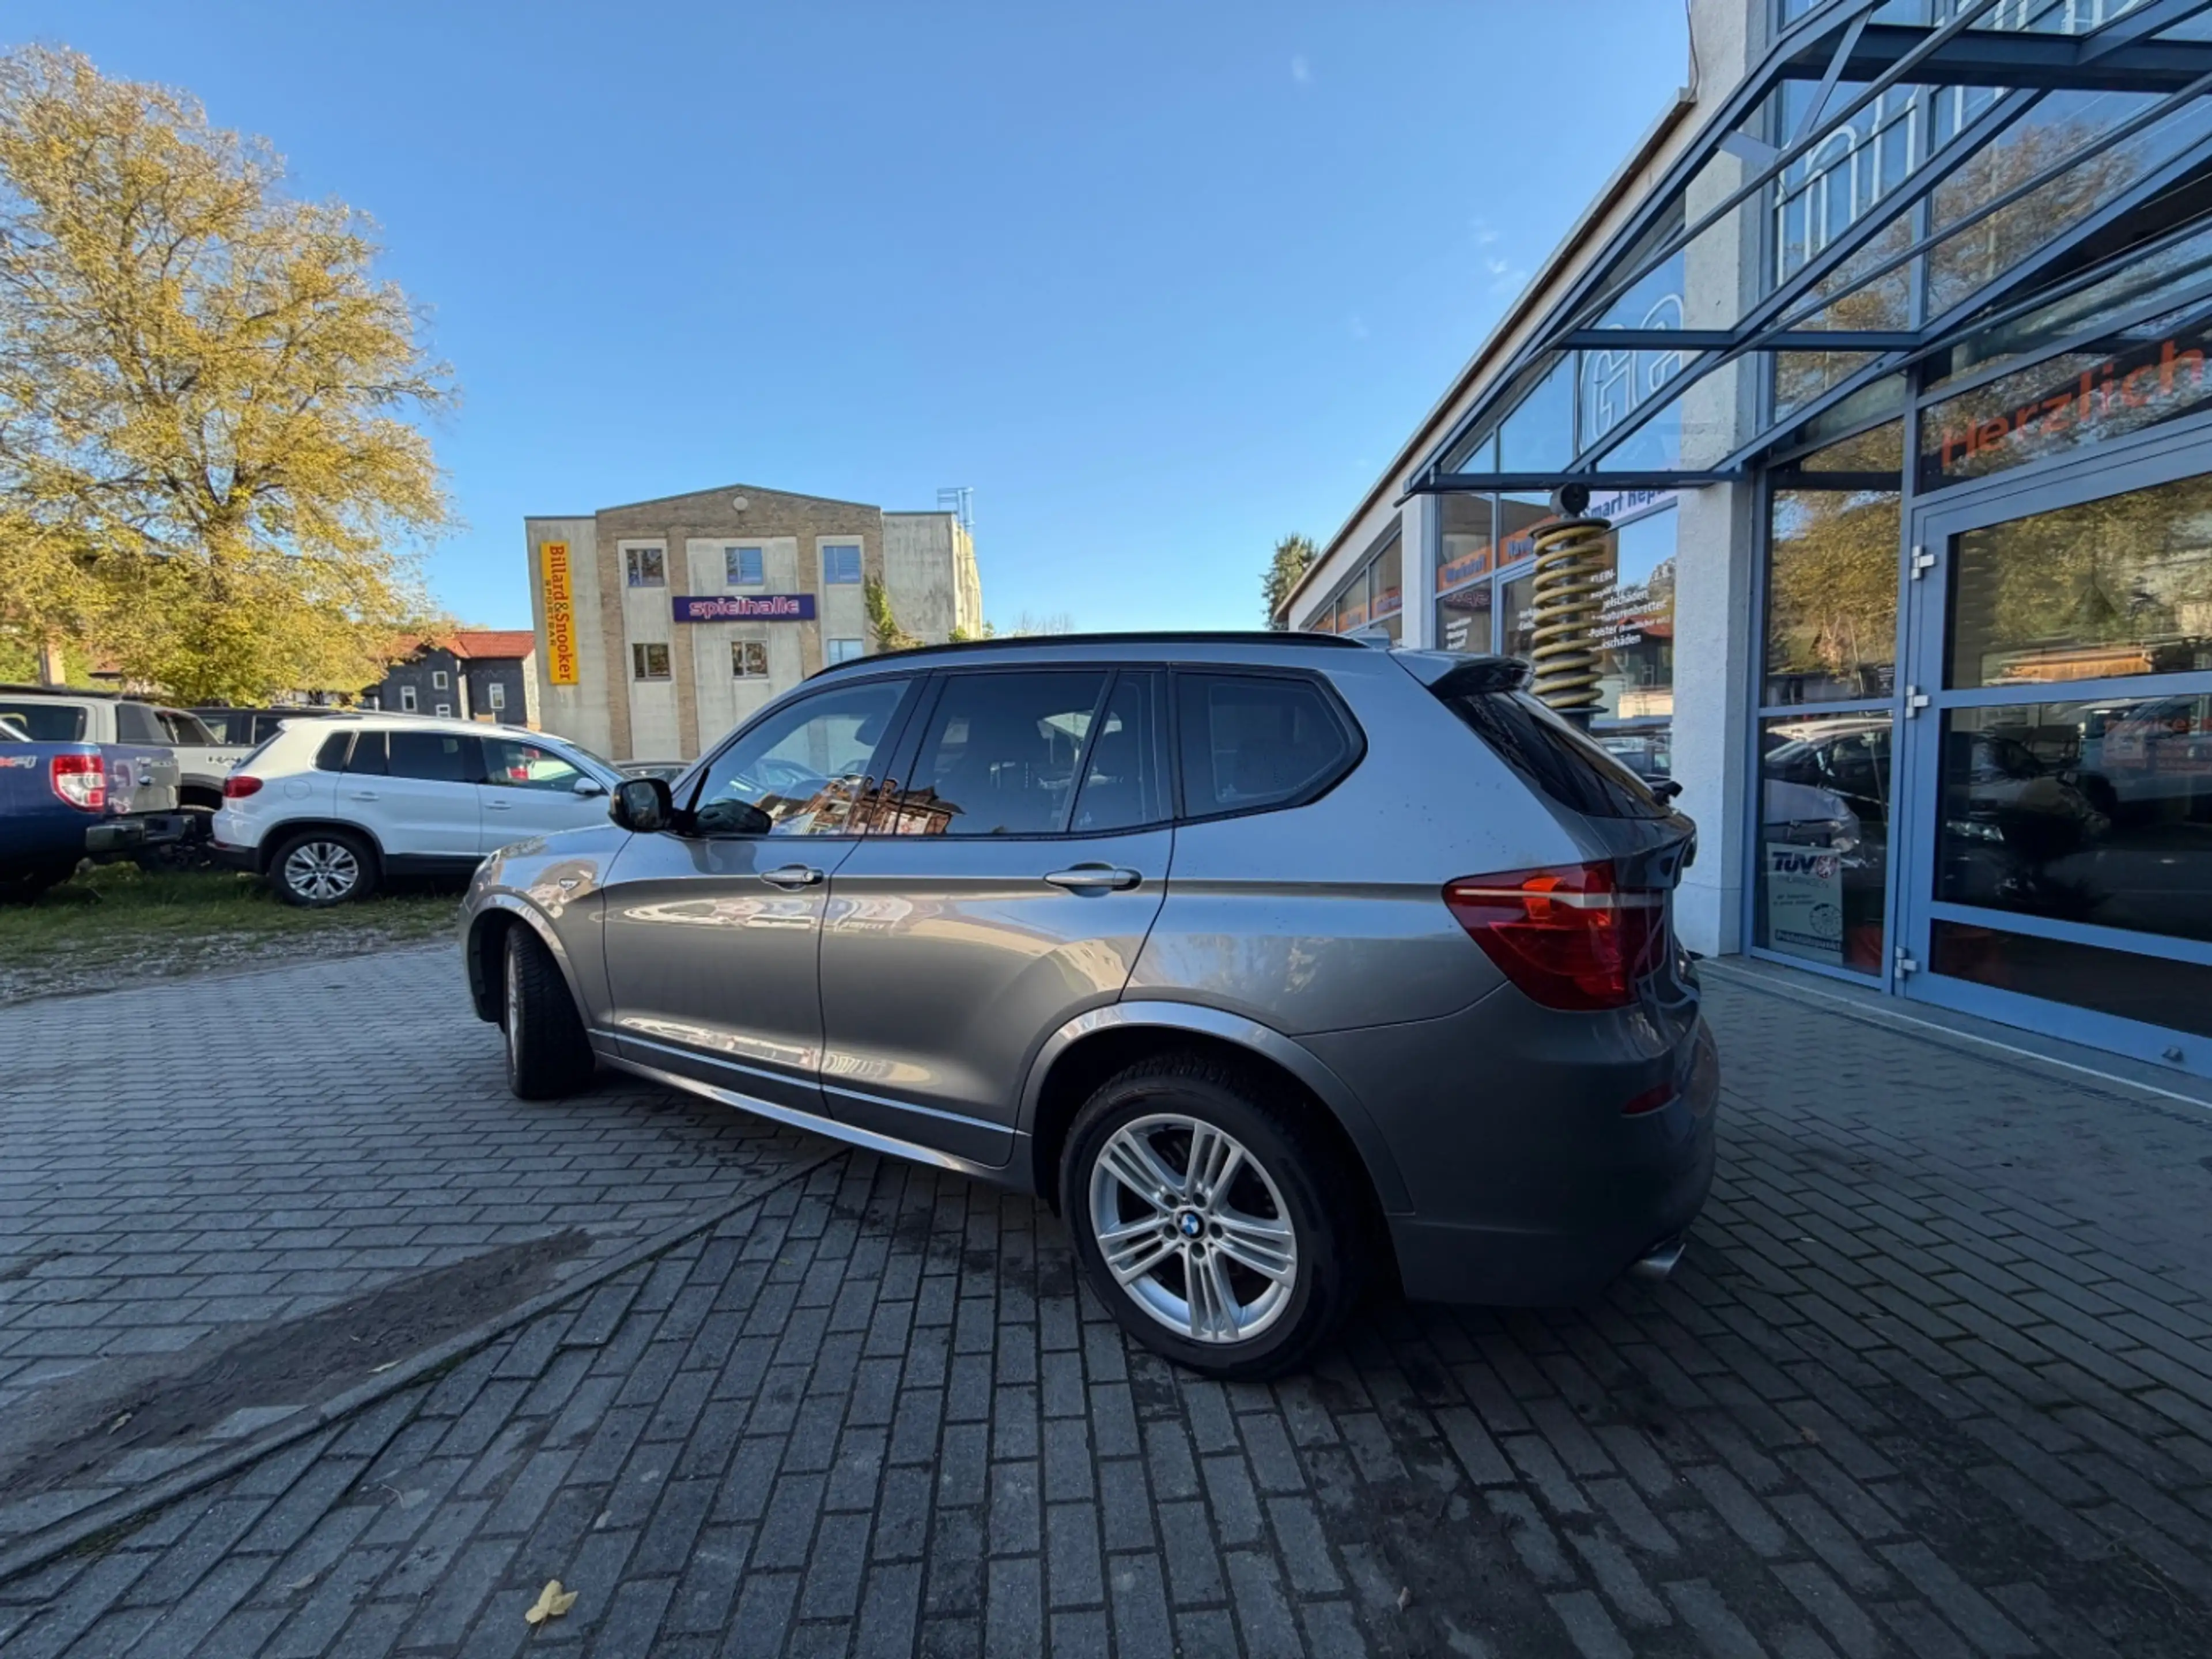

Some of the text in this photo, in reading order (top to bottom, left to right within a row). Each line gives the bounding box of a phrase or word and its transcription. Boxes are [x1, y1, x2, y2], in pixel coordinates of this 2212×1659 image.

[1942, 340, 2205, 468] Herzlich
[1628, 491, 1666, 507] Rep
[689, 596, 799, 619] spielhalle
